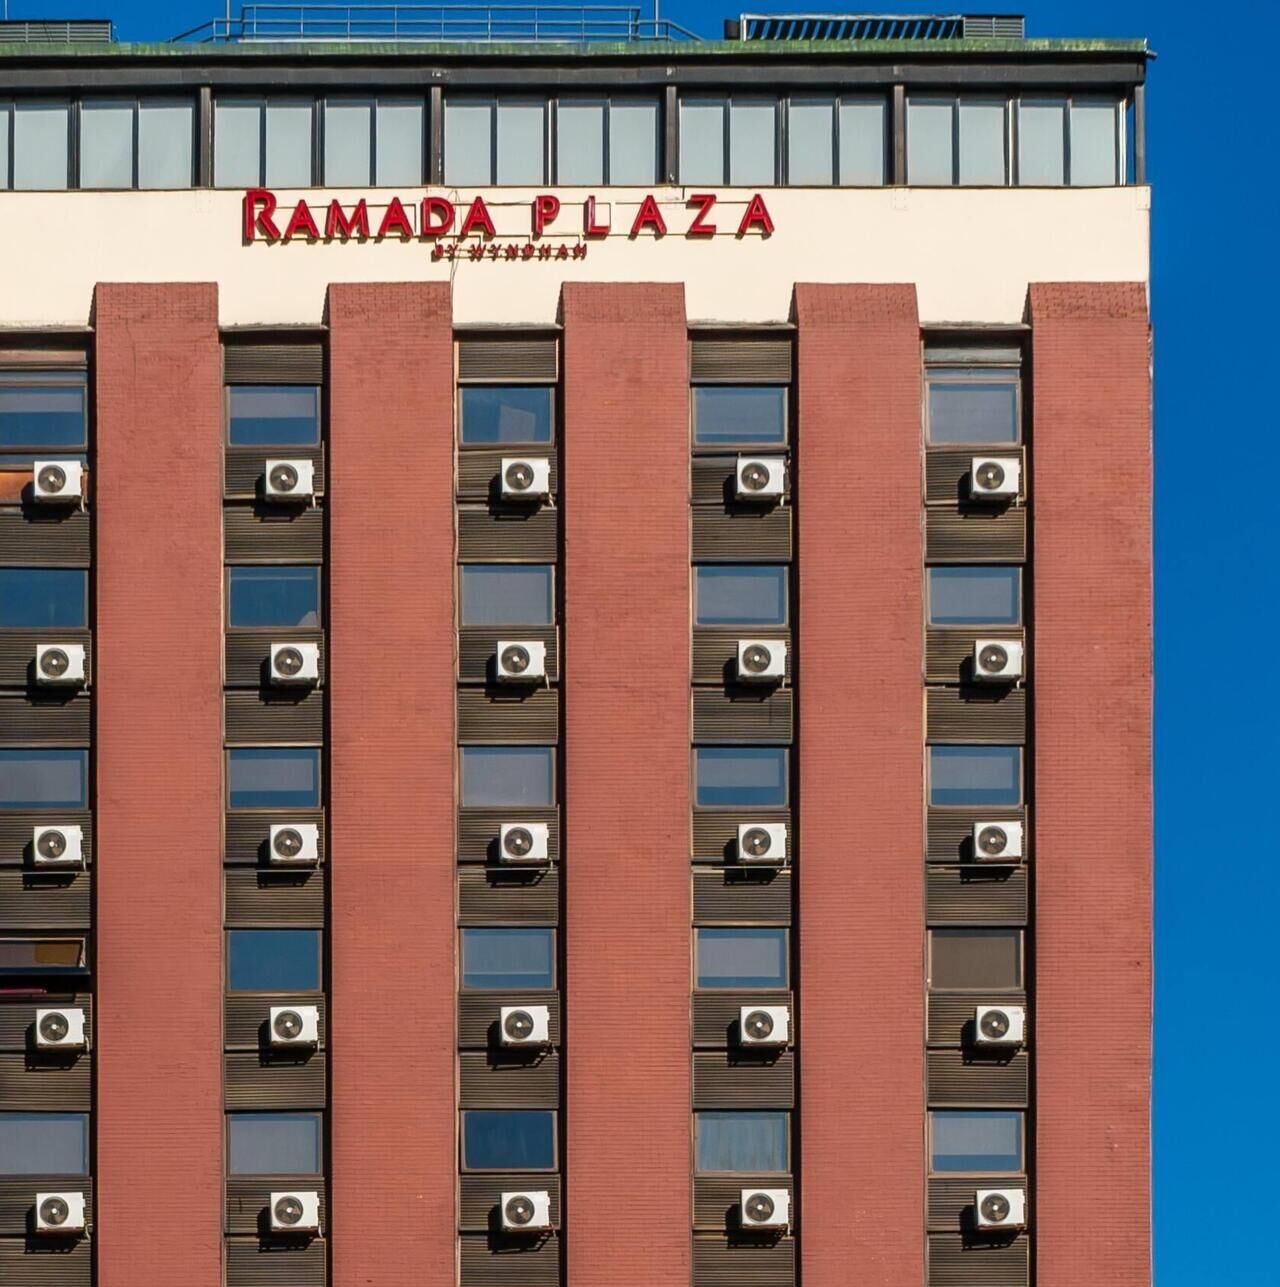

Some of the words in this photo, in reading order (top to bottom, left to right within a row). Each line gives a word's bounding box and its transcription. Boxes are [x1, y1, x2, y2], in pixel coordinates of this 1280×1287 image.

[245, 187, 496, 241] RAMADA
[533, 193, 775, 238] PLAZA
[433, 243, 458, 259] BY
[471, 243, 587, 260] WYNDHAM
